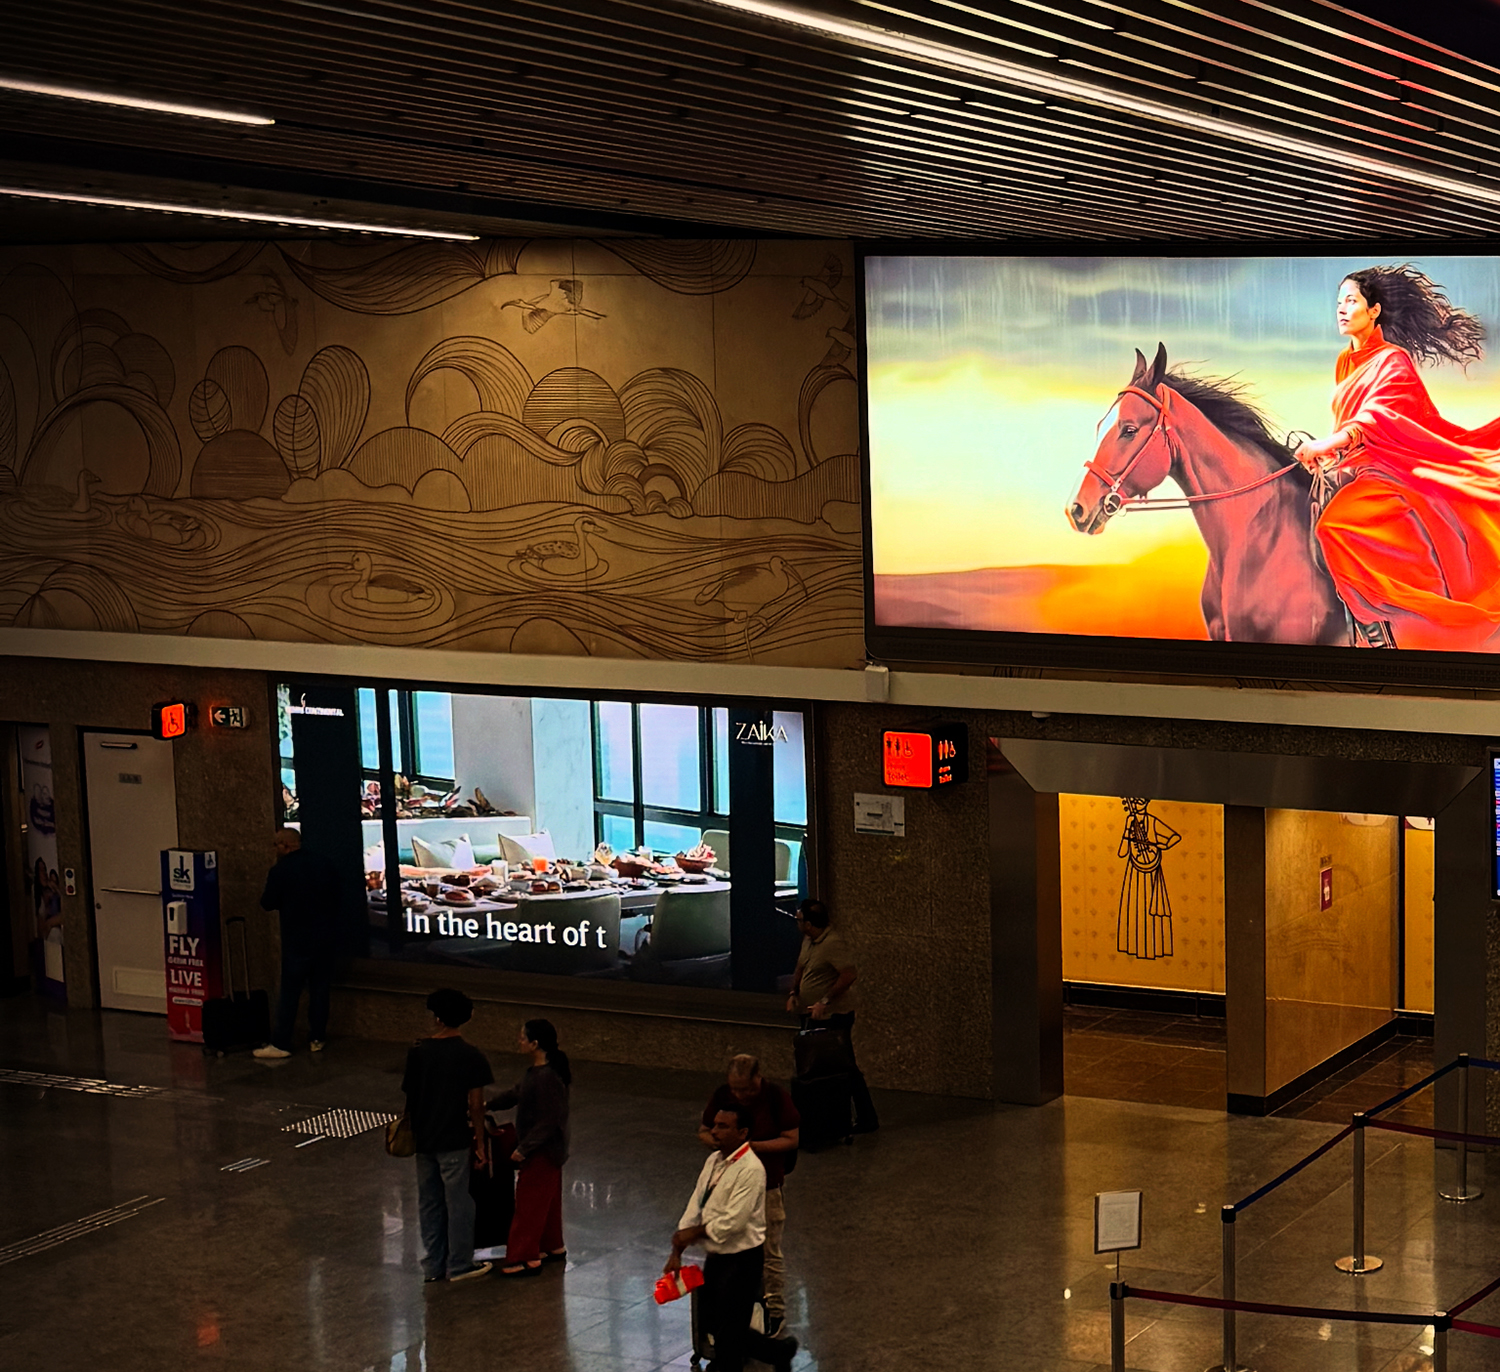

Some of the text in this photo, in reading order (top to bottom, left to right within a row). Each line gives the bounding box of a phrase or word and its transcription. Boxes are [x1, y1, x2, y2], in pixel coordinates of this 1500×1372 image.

[406, 907, 607, 948] In the heart of t
[169, 935, 200, 957] FLY
[170, 969, 202, 987] LIVE
